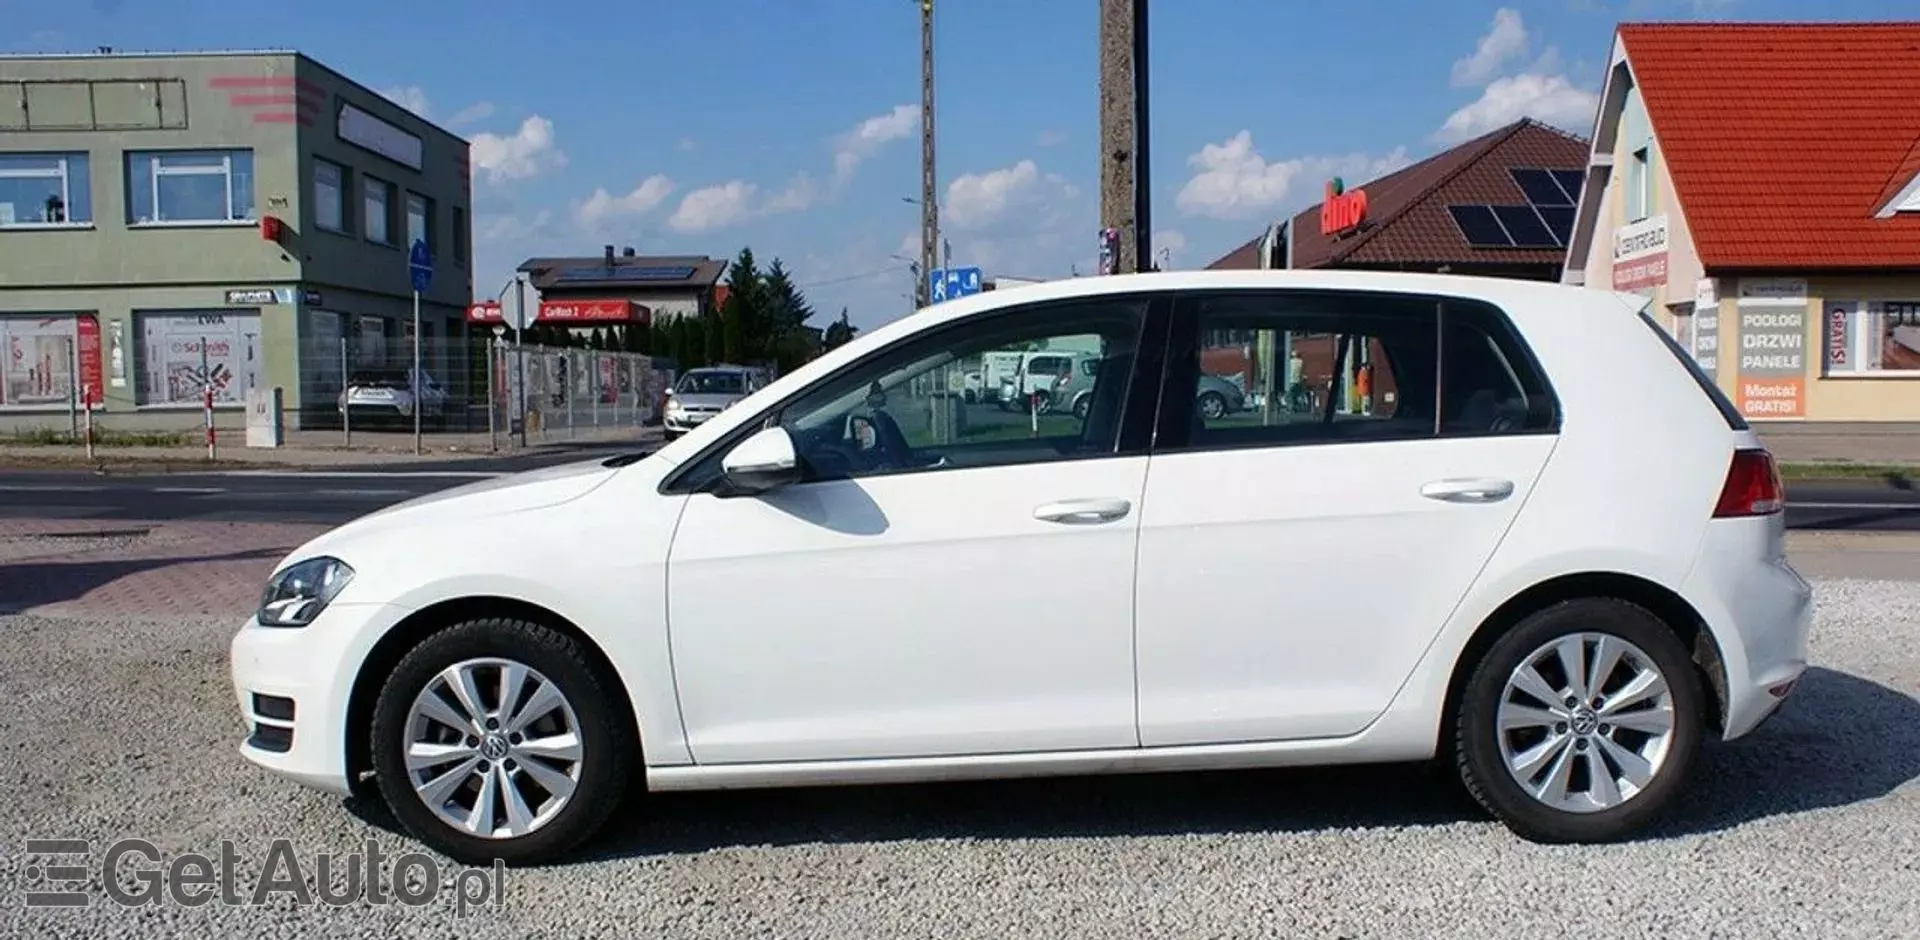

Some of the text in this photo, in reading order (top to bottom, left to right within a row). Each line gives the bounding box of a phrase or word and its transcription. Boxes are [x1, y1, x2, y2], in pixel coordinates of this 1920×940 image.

[1322, 177, 1367, 235] dino
[1743, 314, 1802, 328] PODŁOGI
[1743, 334, 1802, 348] DRZWI
[1830, 308, 1846, 365] GRATIS!
[1743, 355, 1801, 368] PANELE
[1744, 384, 1797, 397] Montaż
[1744, 401, 1797, 413] GRATIS!
